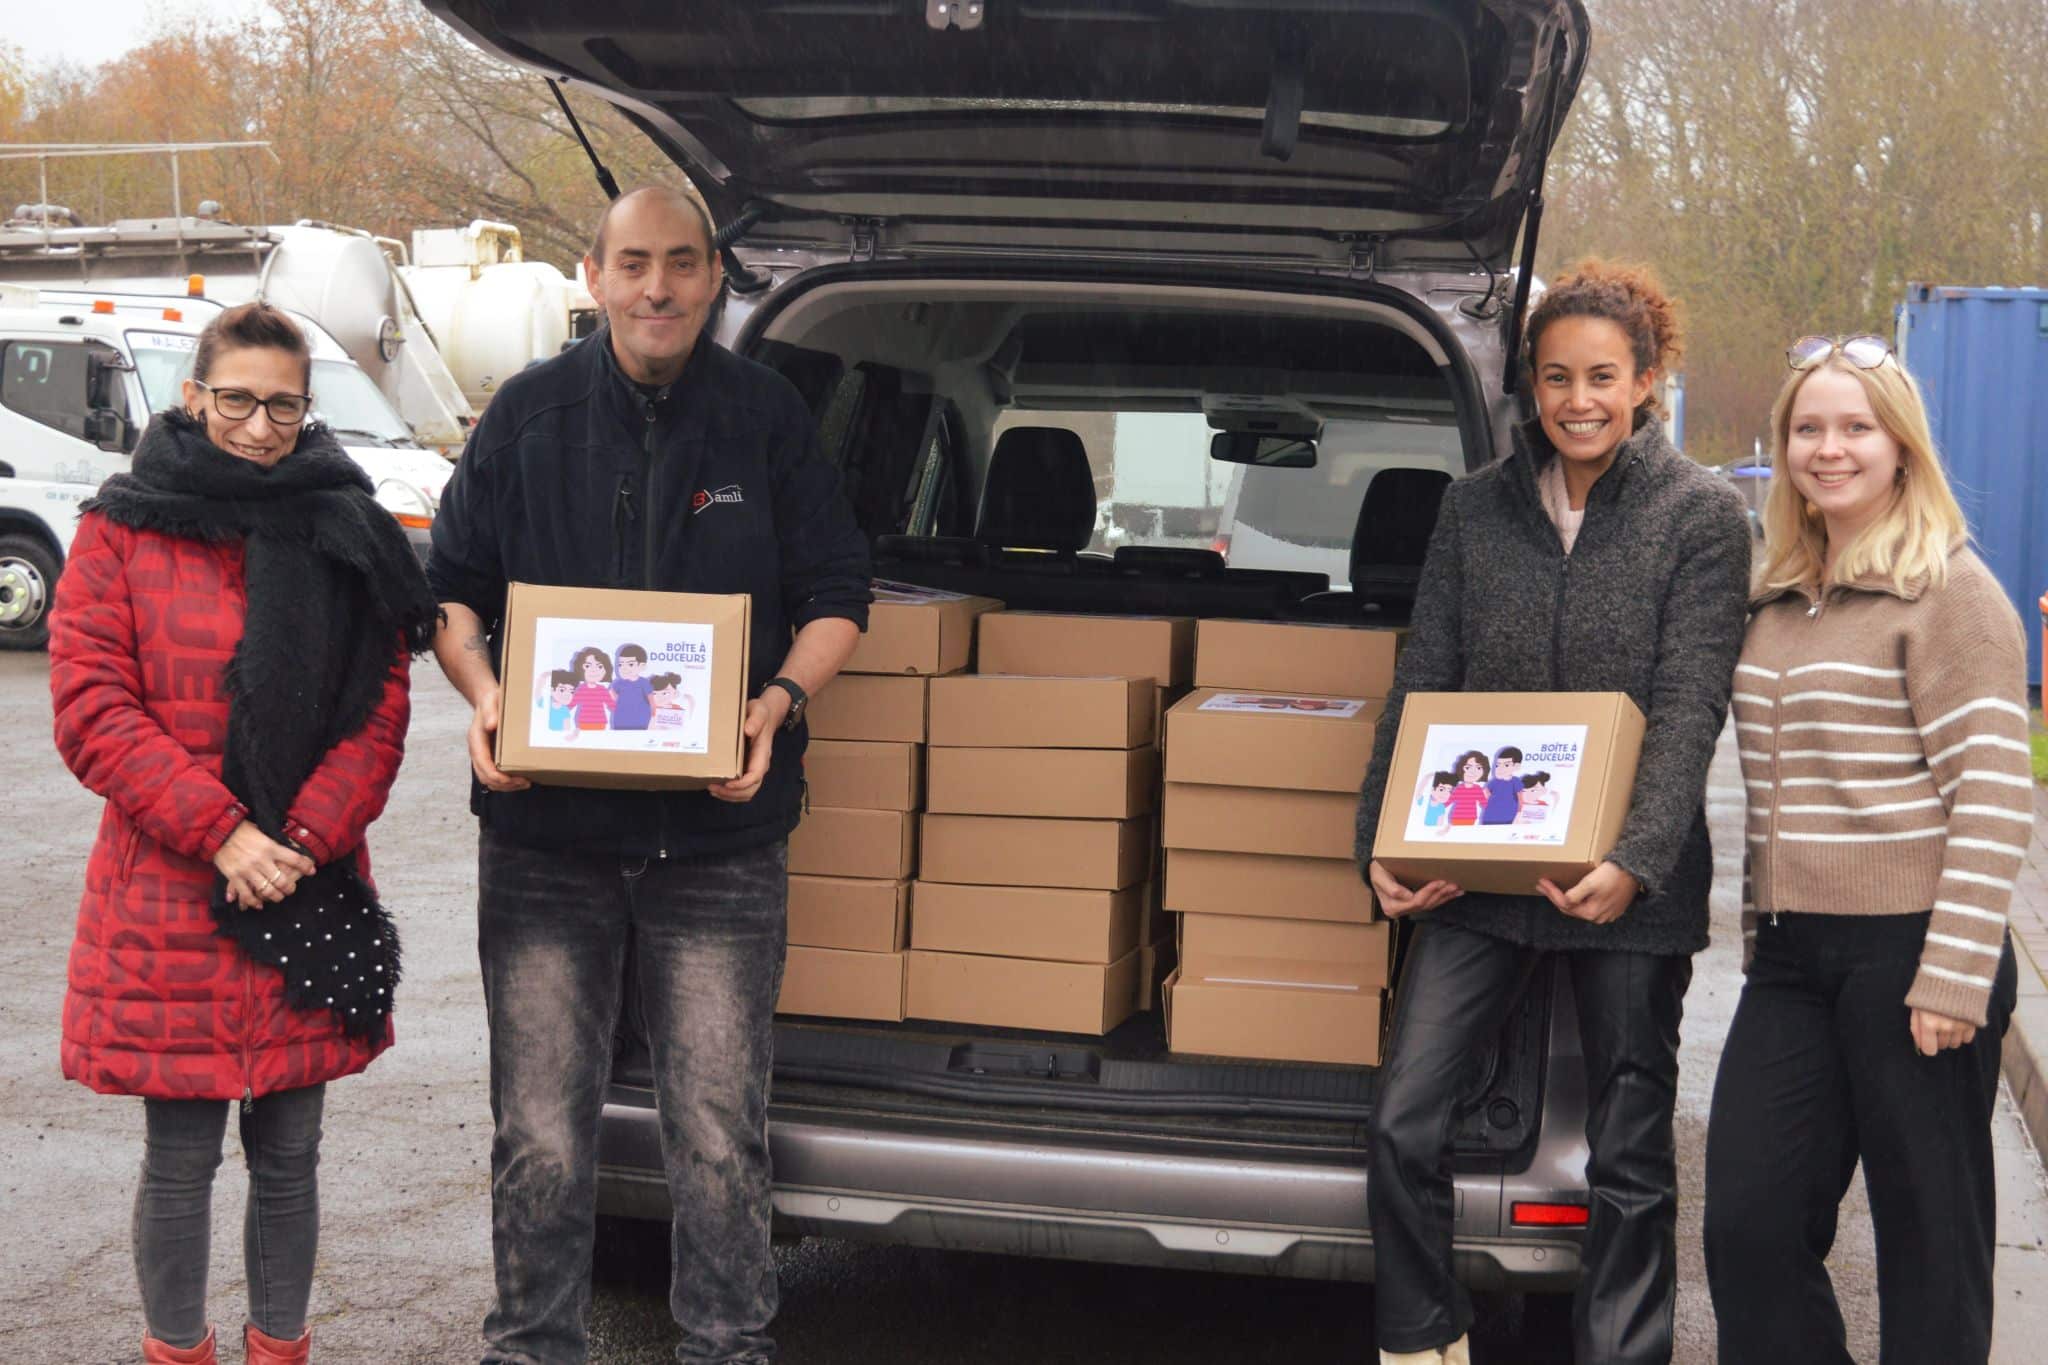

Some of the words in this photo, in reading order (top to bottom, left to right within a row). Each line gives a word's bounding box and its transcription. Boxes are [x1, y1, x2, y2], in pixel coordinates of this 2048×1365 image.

[666, 640, 697, 653] BOÎTE
[650, 652, 706, 663] DOUCEURS
[1525, 753, 1576, 761] DOUCEURS
